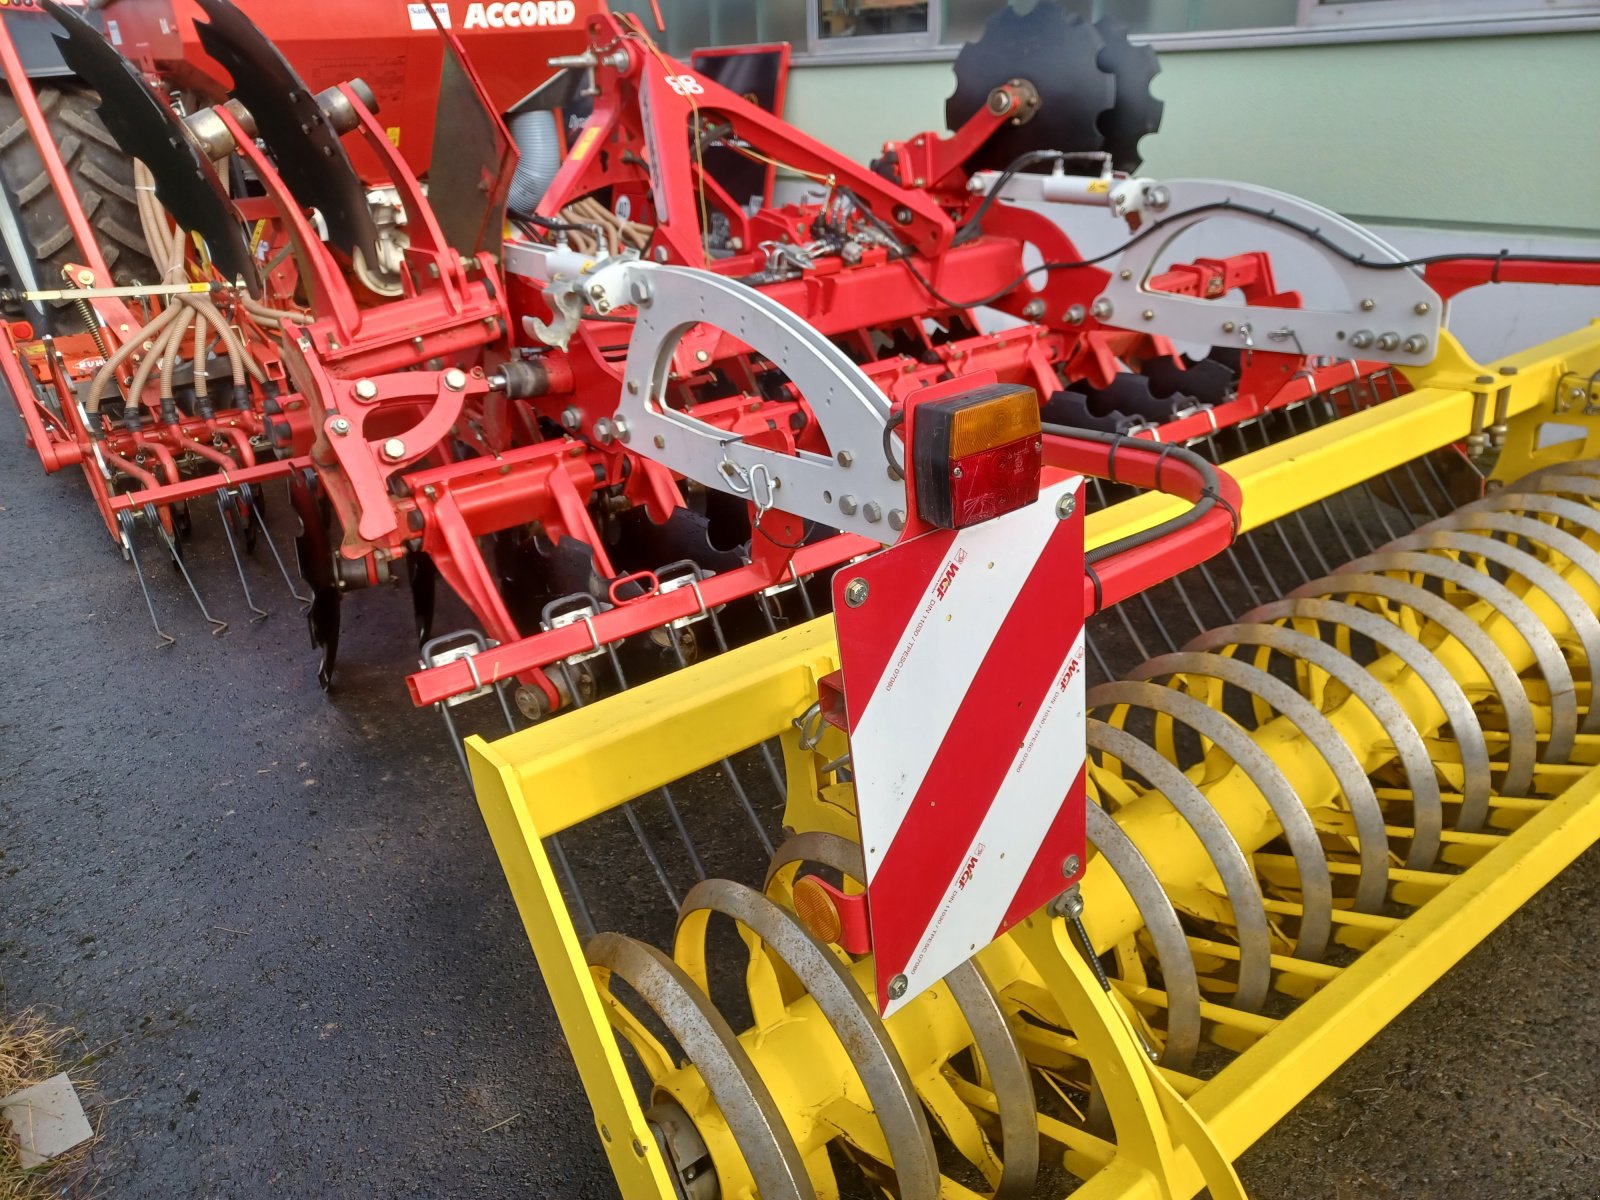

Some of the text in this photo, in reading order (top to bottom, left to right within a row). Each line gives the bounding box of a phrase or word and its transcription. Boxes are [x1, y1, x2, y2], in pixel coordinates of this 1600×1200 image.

[463, 0, 576, 29] ACCORD
[936, 562, 960, 602] WGF
[925, 599, 937, 614] DIN
[912, 615, 928, 637] 11030
[897, 641, 914, 668] TPESC
[1059, 659, 1079, 693] WGF
[1039, 704, 1053, 725] 11030
[1026, 729, 1041, 752] TPESC
[957, 856, 978, 891] WGF
[936, 904, 951, 925] 11030
[921, 929, 937, 954] TPESC
